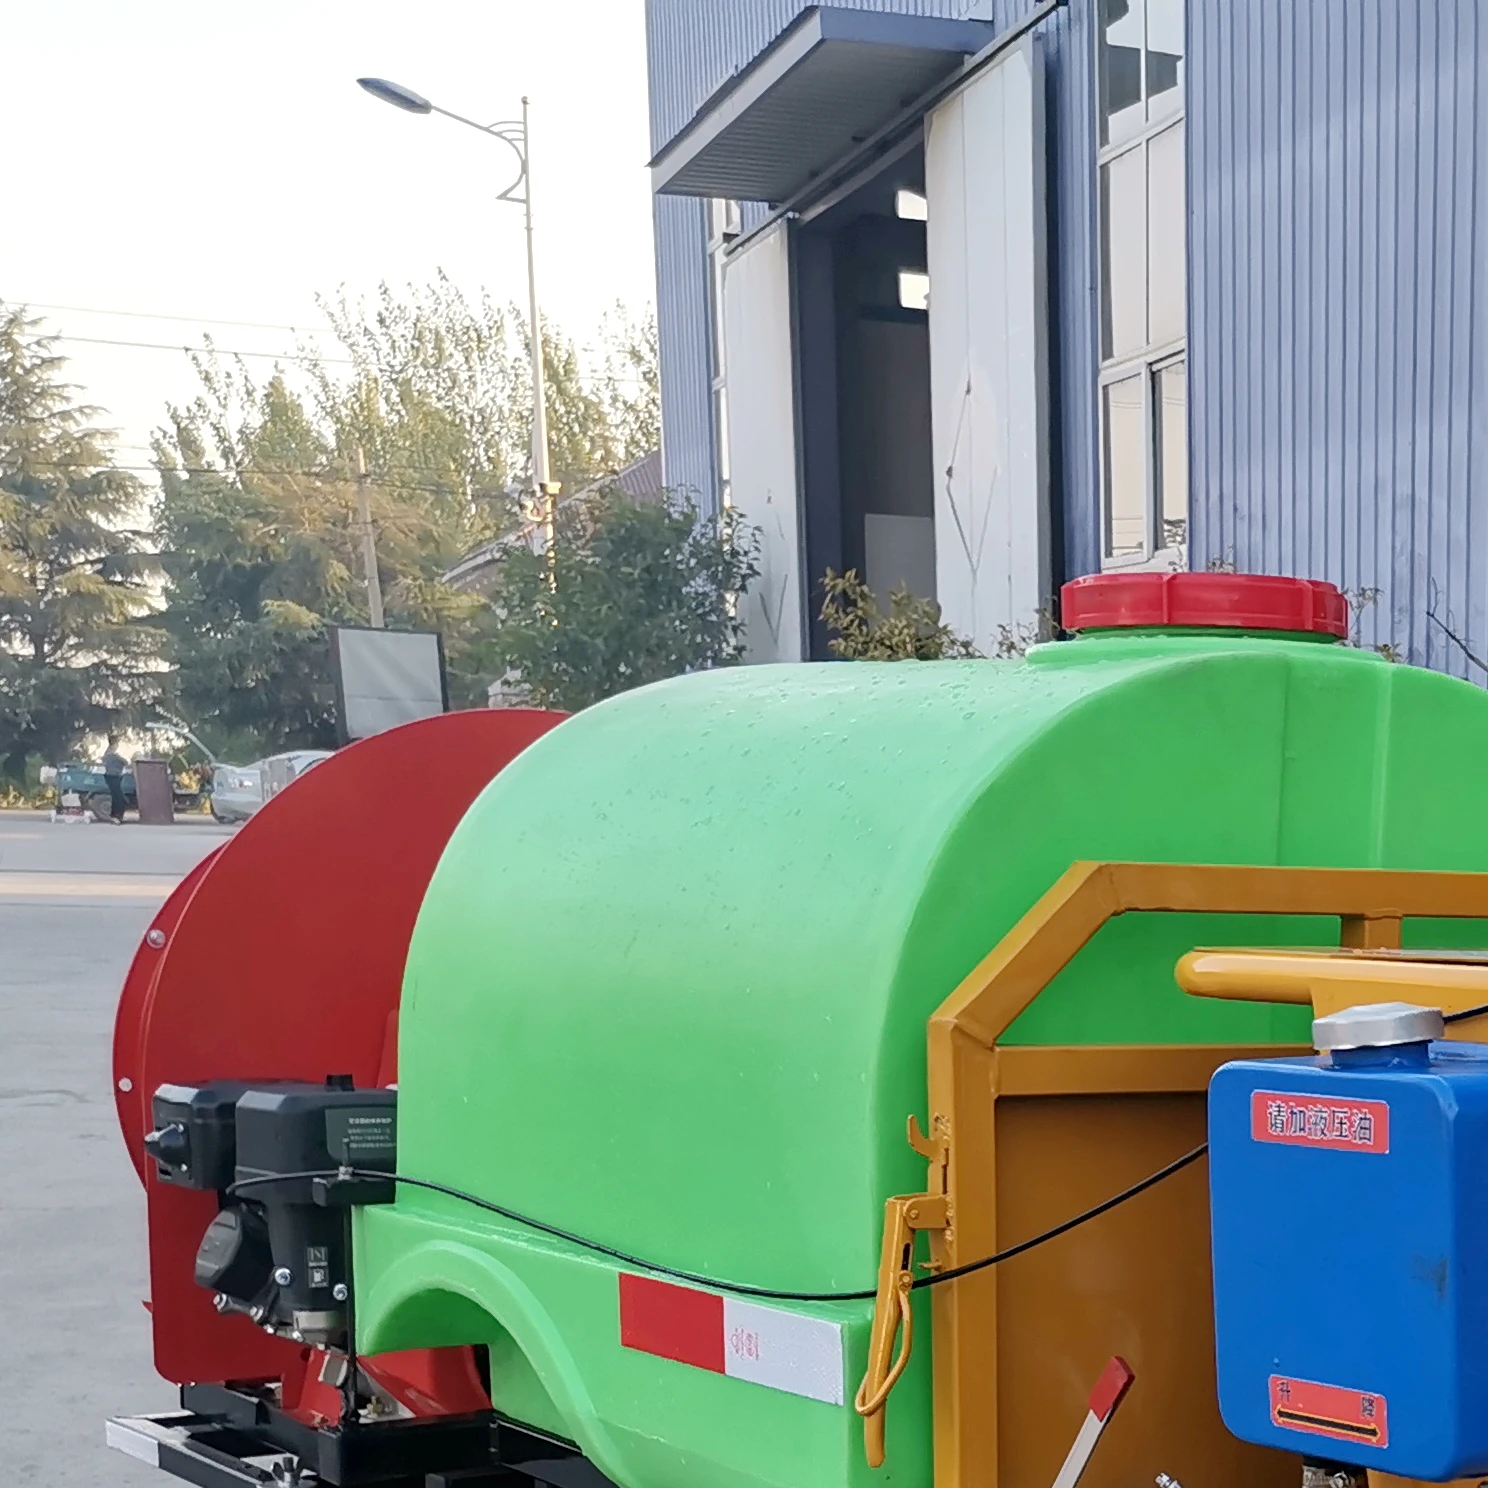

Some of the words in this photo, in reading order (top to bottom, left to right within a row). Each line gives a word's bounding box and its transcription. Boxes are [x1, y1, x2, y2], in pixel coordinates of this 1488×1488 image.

[1266, 1100, 1374, 1145] 请加液压油
